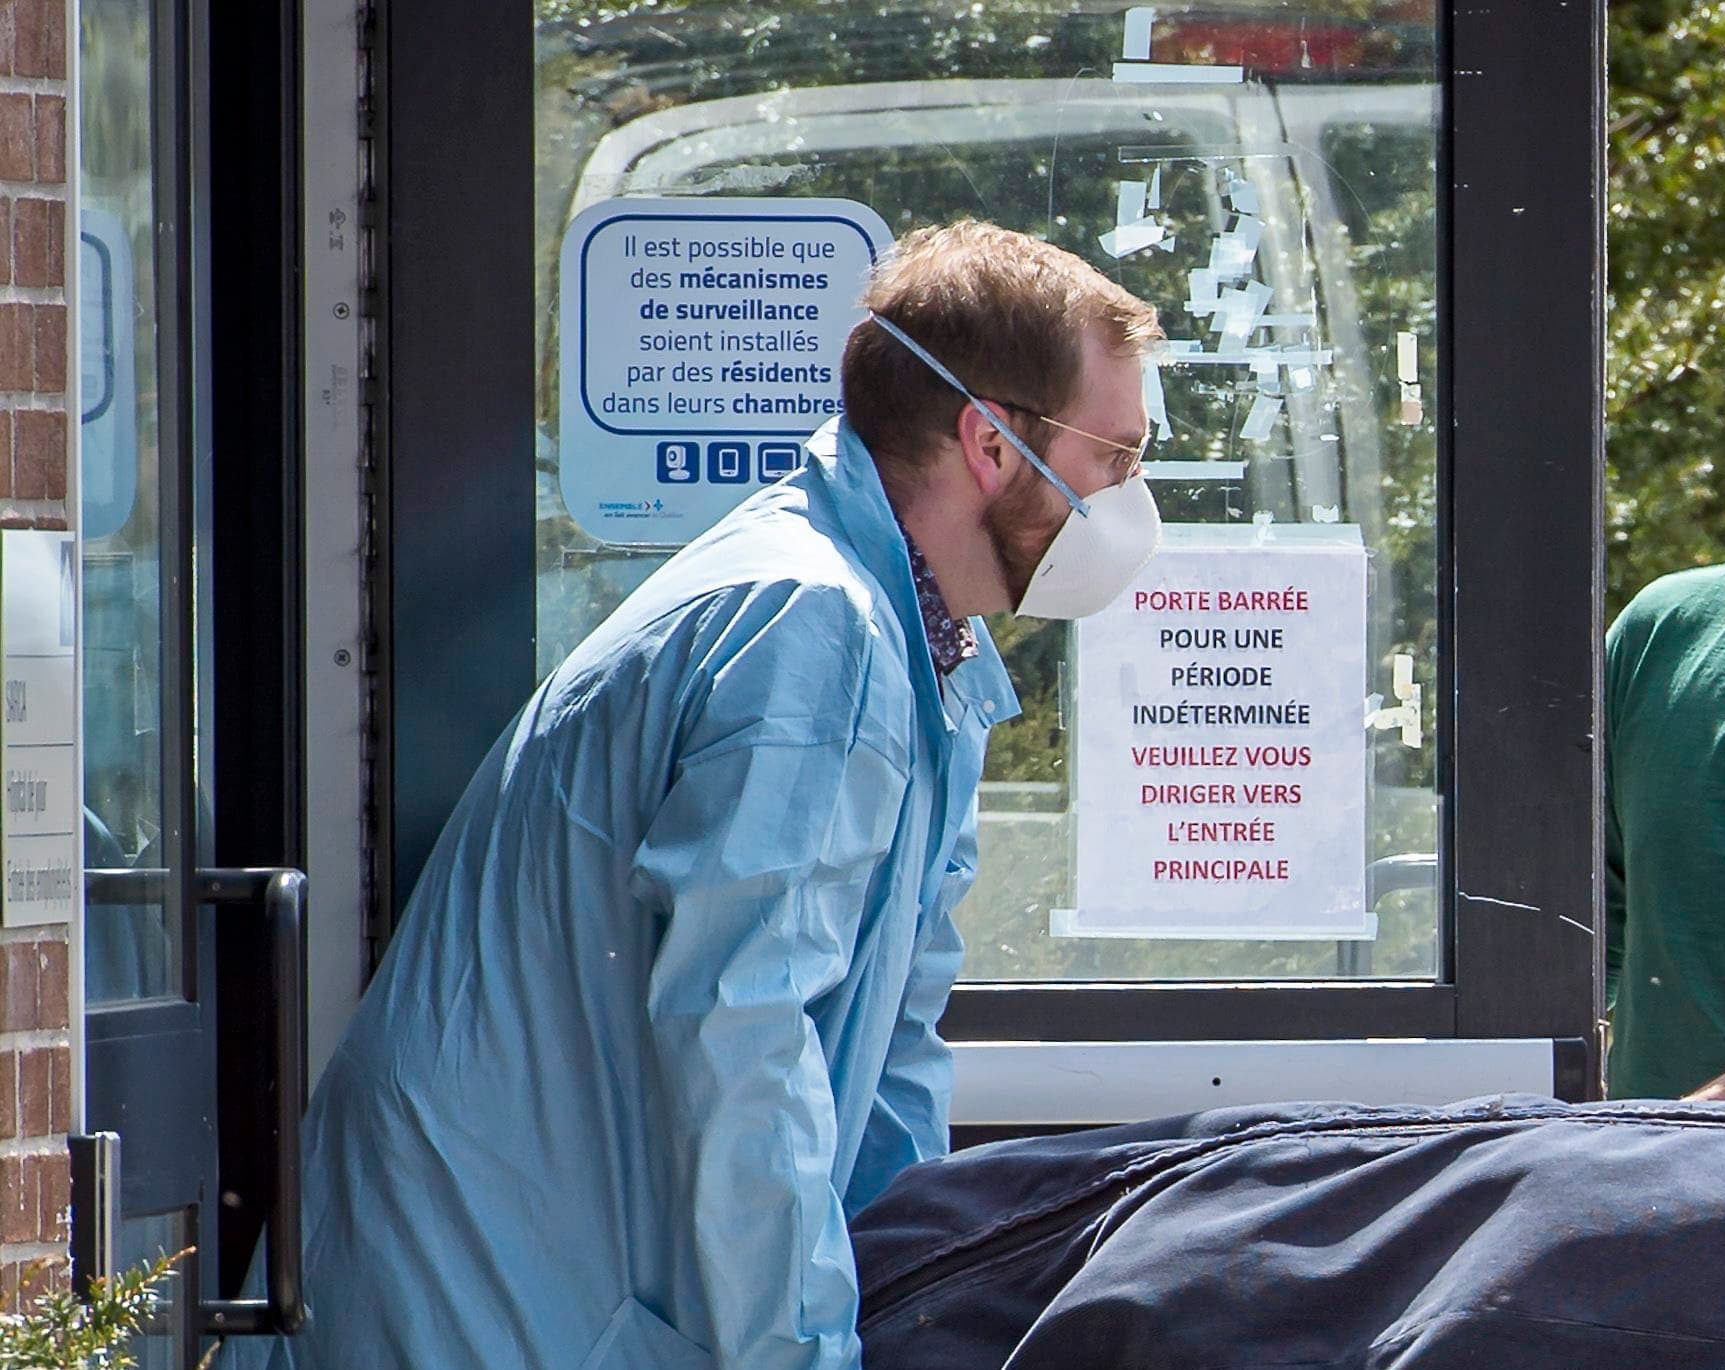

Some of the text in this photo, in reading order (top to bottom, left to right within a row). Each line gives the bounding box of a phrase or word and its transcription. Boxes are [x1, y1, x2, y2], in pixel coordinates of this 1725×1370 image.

[625, 235, 836, 265] Il est possible que
[630, 265, 829, 290] des mécanismes
[640, 298, 820, 321] de surveillance
[639, 329, 819, 353] soient installés
[627, 360, 832, 389] par des résidents
[602, 391, 660, 414] dans
[667, 391, 726, 415] leurs
[1135, 585, 1309, 611] PORTE BARRÉE
[1160, 628, 1284, 649] POUR UNE
[1171, 661, 1273, 688] PÉRIODE
[1133, 699, 1311, 725] INDÉTERMINÉE
[1131, 746, 1312, 767] VEUILLEZ VOUS
[1141, 784, 1302, 805] DIRIGER VERS
[1154, 859, 1289, 880] PRINCIPALE
